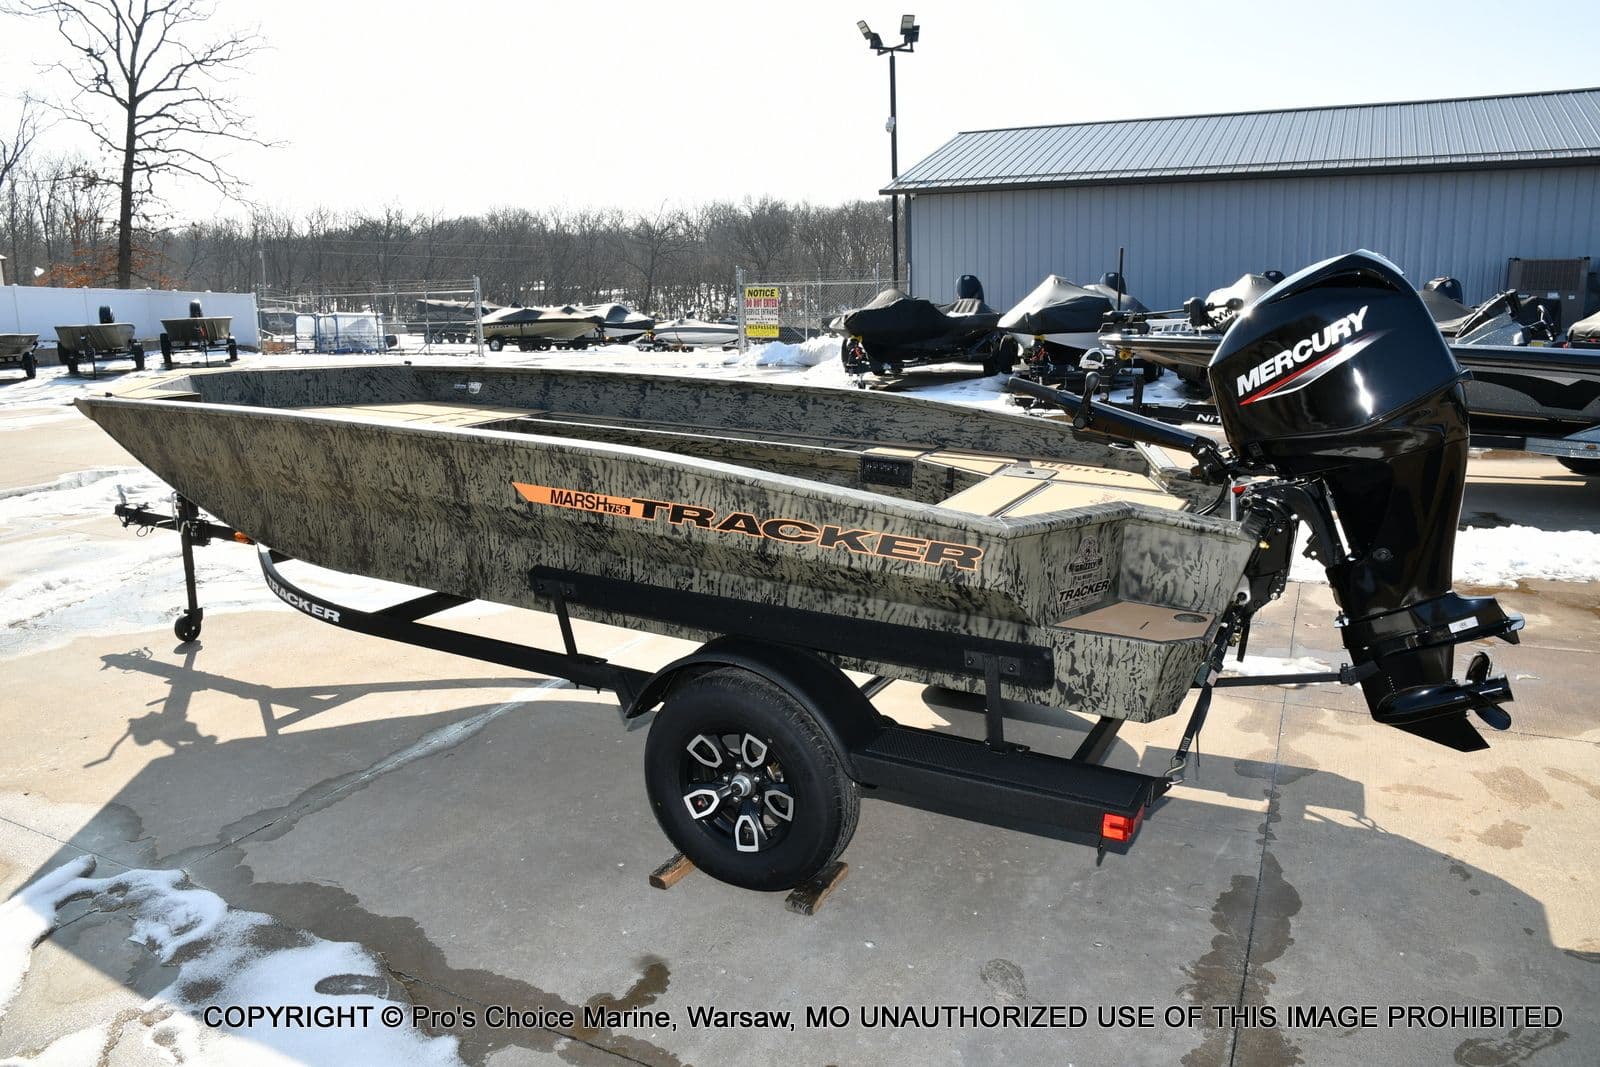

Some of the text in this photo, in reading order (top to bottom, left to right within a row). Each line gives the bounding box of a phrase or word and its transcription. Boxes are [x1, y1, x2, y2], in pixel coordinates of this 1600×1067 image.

[746, 298, 778, 308] DO NOT ENTER
[747, 289, 776, 297] NOTICE
[1237, 305, 1369, 398] MERCURY
[550, 489, 984, 571] MARSH 1756 TRACKER
[267, 575, 341, 622] TRACKER
[1060, 580, 1109, 602] TRACKER
